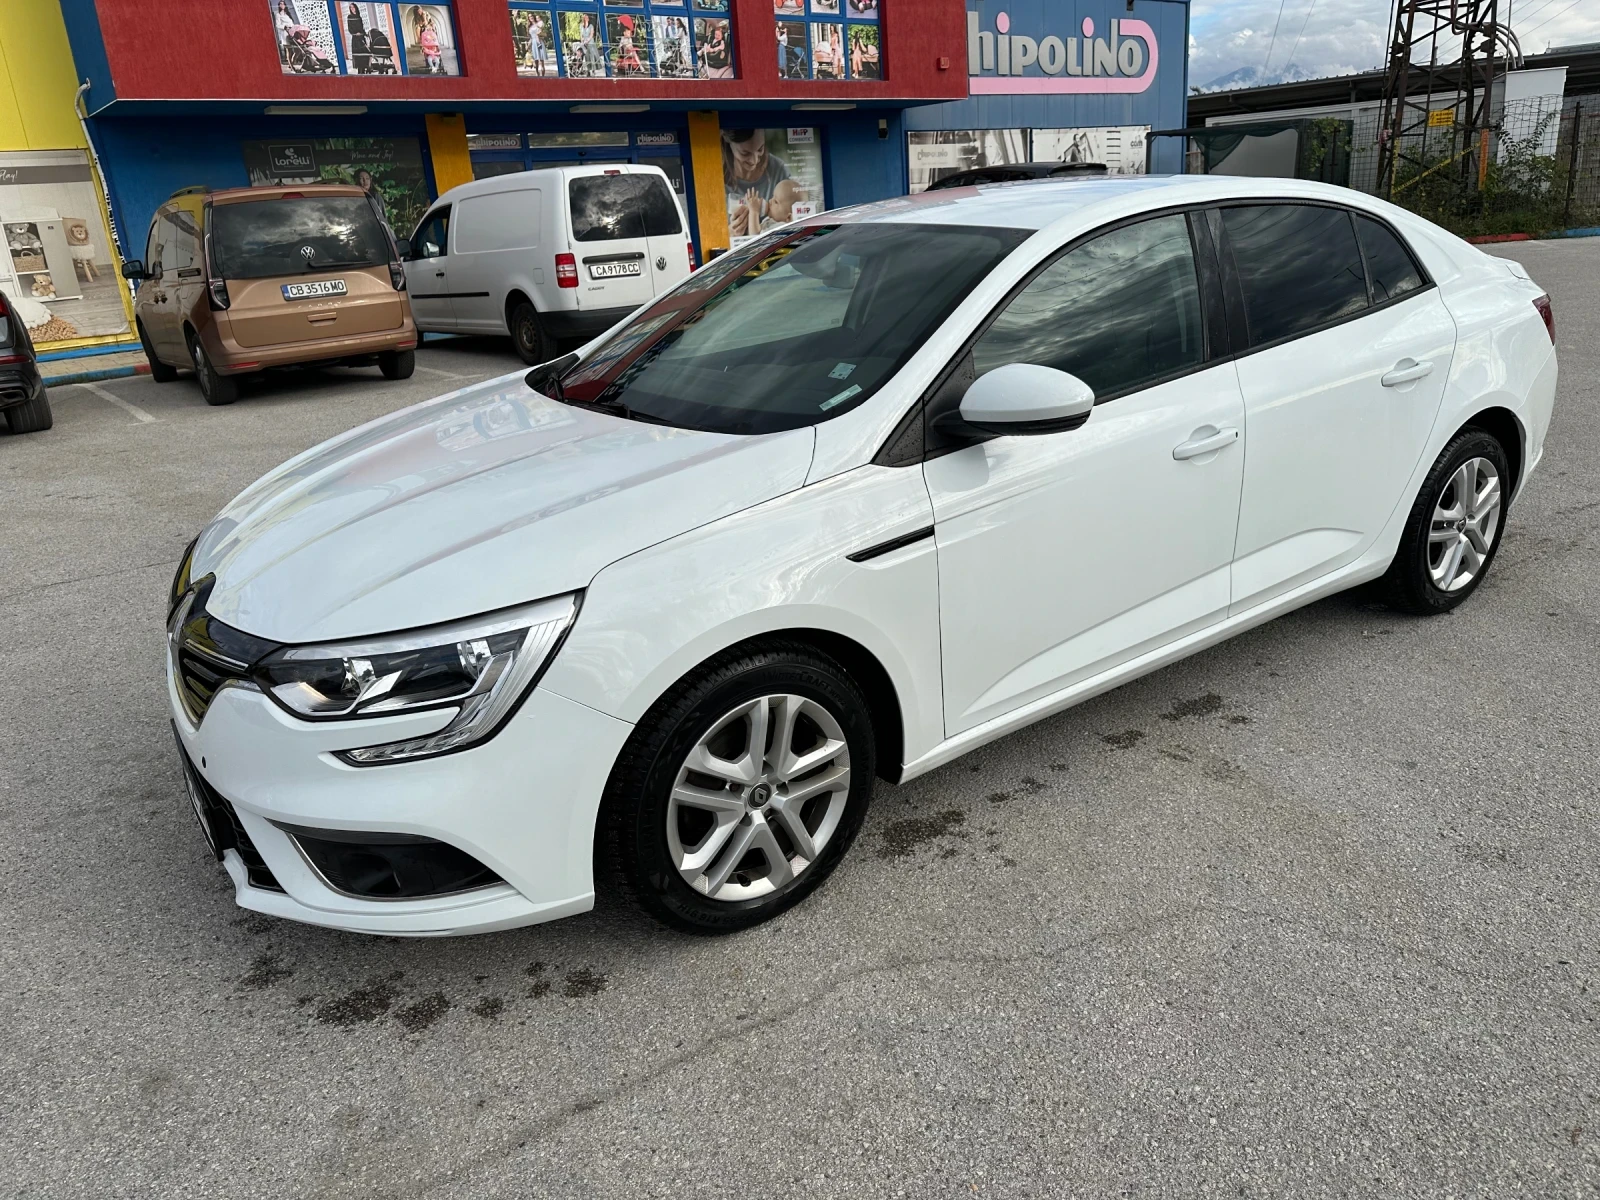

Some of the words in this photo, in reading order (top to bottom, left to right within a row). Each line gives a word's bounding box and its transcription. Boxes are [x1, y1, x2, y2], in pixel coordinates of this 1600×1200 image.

[596, 266, 608, 275] CA
[608, 264, 627, 274] 9178
[628, 263, 638, 272] CC
[290, 285, 304, 295] CB
[305, 282, 330, 294] 3516
[330, 281, 344, 291] MO
